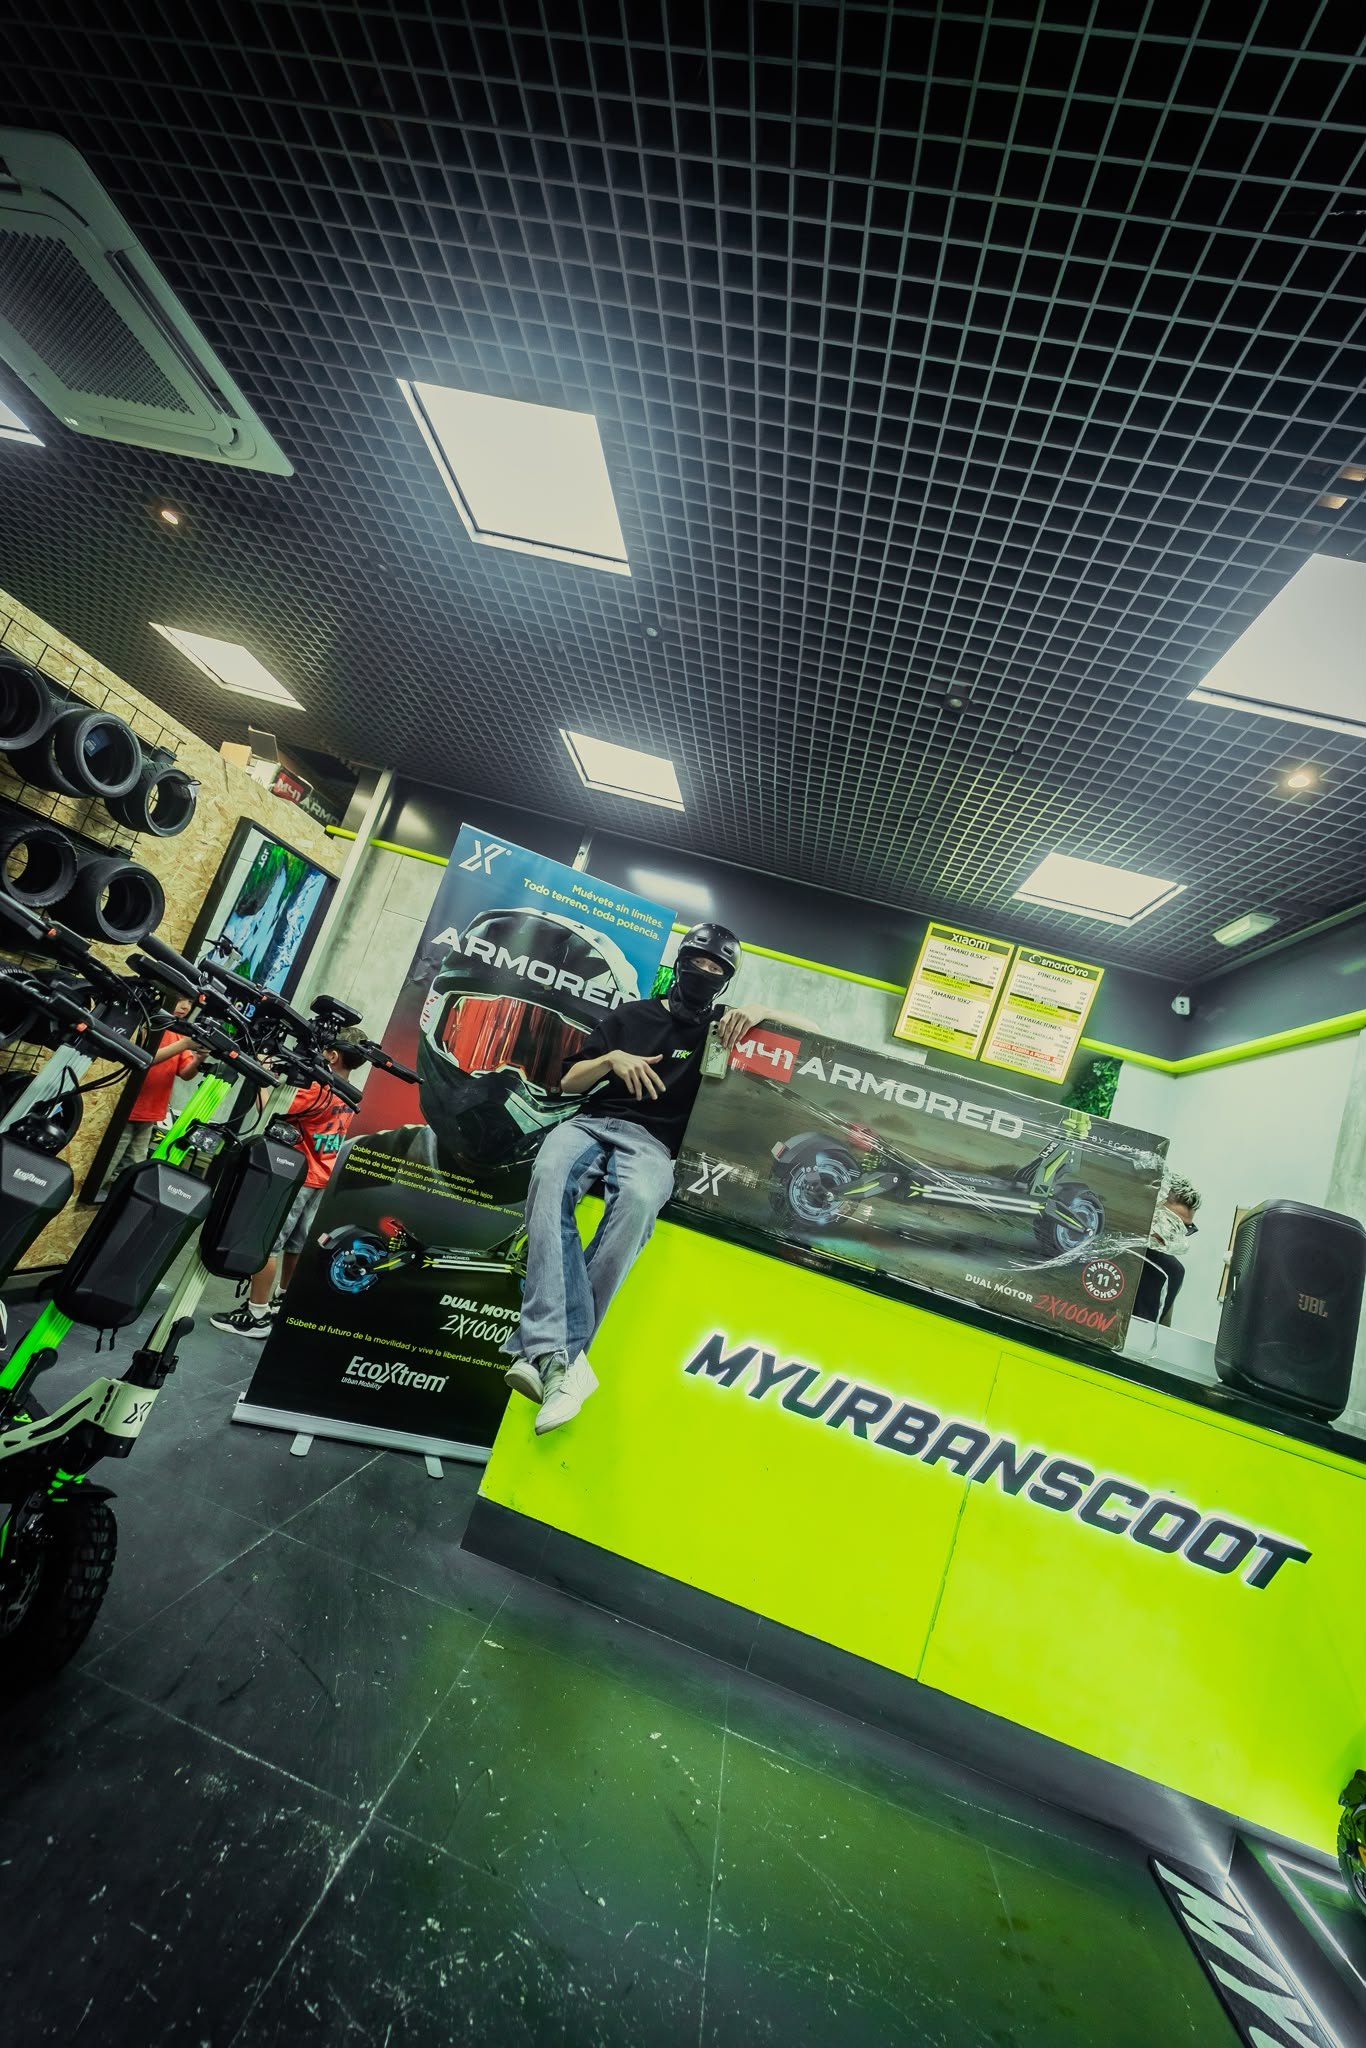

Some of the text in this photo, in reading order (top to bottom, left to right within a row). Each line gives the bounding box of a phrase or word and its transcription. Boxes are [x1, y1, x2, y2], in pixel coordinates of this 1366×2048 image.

[524, 878, 660, 941] Todo terreno, toda potencia.
[572, 884, 664, 929] Muévete sin límites.
[1040, 957, 1089, 978] smartGyro
[735, 1040, 1024, 1139] M41 ARMORED
[312, 1132, 346, 1152] TEA
[348, 1153, 493, 1200] Batería de larga duración para aventuras más lejos
[352, 1144, 372, 1155] Doble
[372, 1150, 391, 1160] motor
[391, 1156, 406, 1165] para
[415, 1162, 451, 1178] rendimiento
[451, 1173, 475, 1184] superior
[345, 1163, 367, 1175] Diseño
[367, 1170, 396, 1184] moderno,
[397, 1178, 427, 1191] resistente
[432, 1188, 463, 1201] preparado
[462, 1197, 476, 1205] para
[477, 1201, 503, 1213] cualquier
[503, 1207, 524, 1218] terreno
[1086, 1281, 1118, 1299] INCHES
[1088, 1262, 1121, 1281] WHEELS
[1097, 1273, 1110, 1287] 11
[440, 1294, 521, 1323] DUAL MOTO
[965, 1274, 1117, 1332] DUAL MOTOR 2X1000W
[1298, 1293, 1329, 1318] JBL
[286, 1317, 512, 1372] ¡Súbete al futuro de la movilidad y vive la libertad sobre rued
[341, 1376, 383, 1391] Urban Mobility
[345, 1355, 448, 1393] EcoXtrem
[685, 1334, 1312, 1590] MYURBANSCOOT
